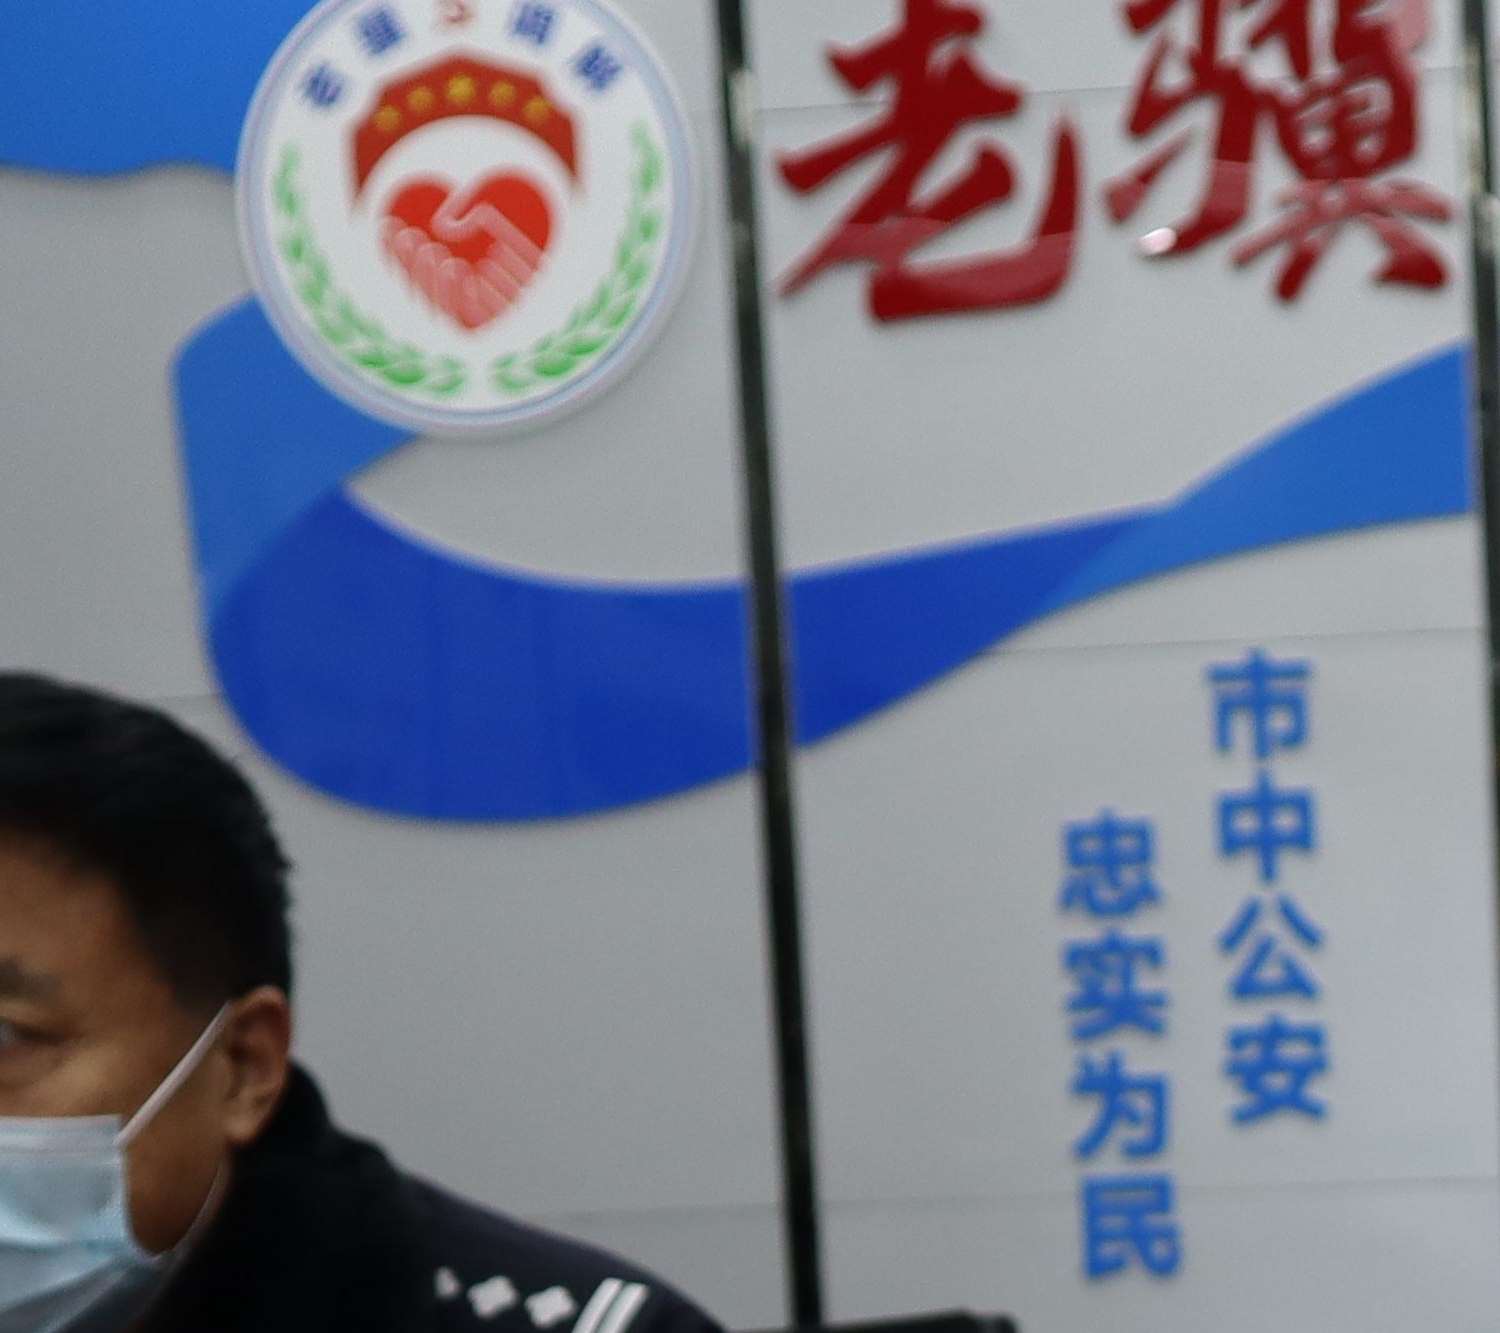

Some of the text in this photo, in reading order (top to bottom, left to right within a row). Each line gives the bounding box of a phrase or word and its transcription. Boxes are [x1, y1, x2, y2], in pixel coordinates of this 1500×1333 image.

[1060, 808, 1184, 1282] 忠实为民
[1204, 646, 1328, 1126] 市中公安
